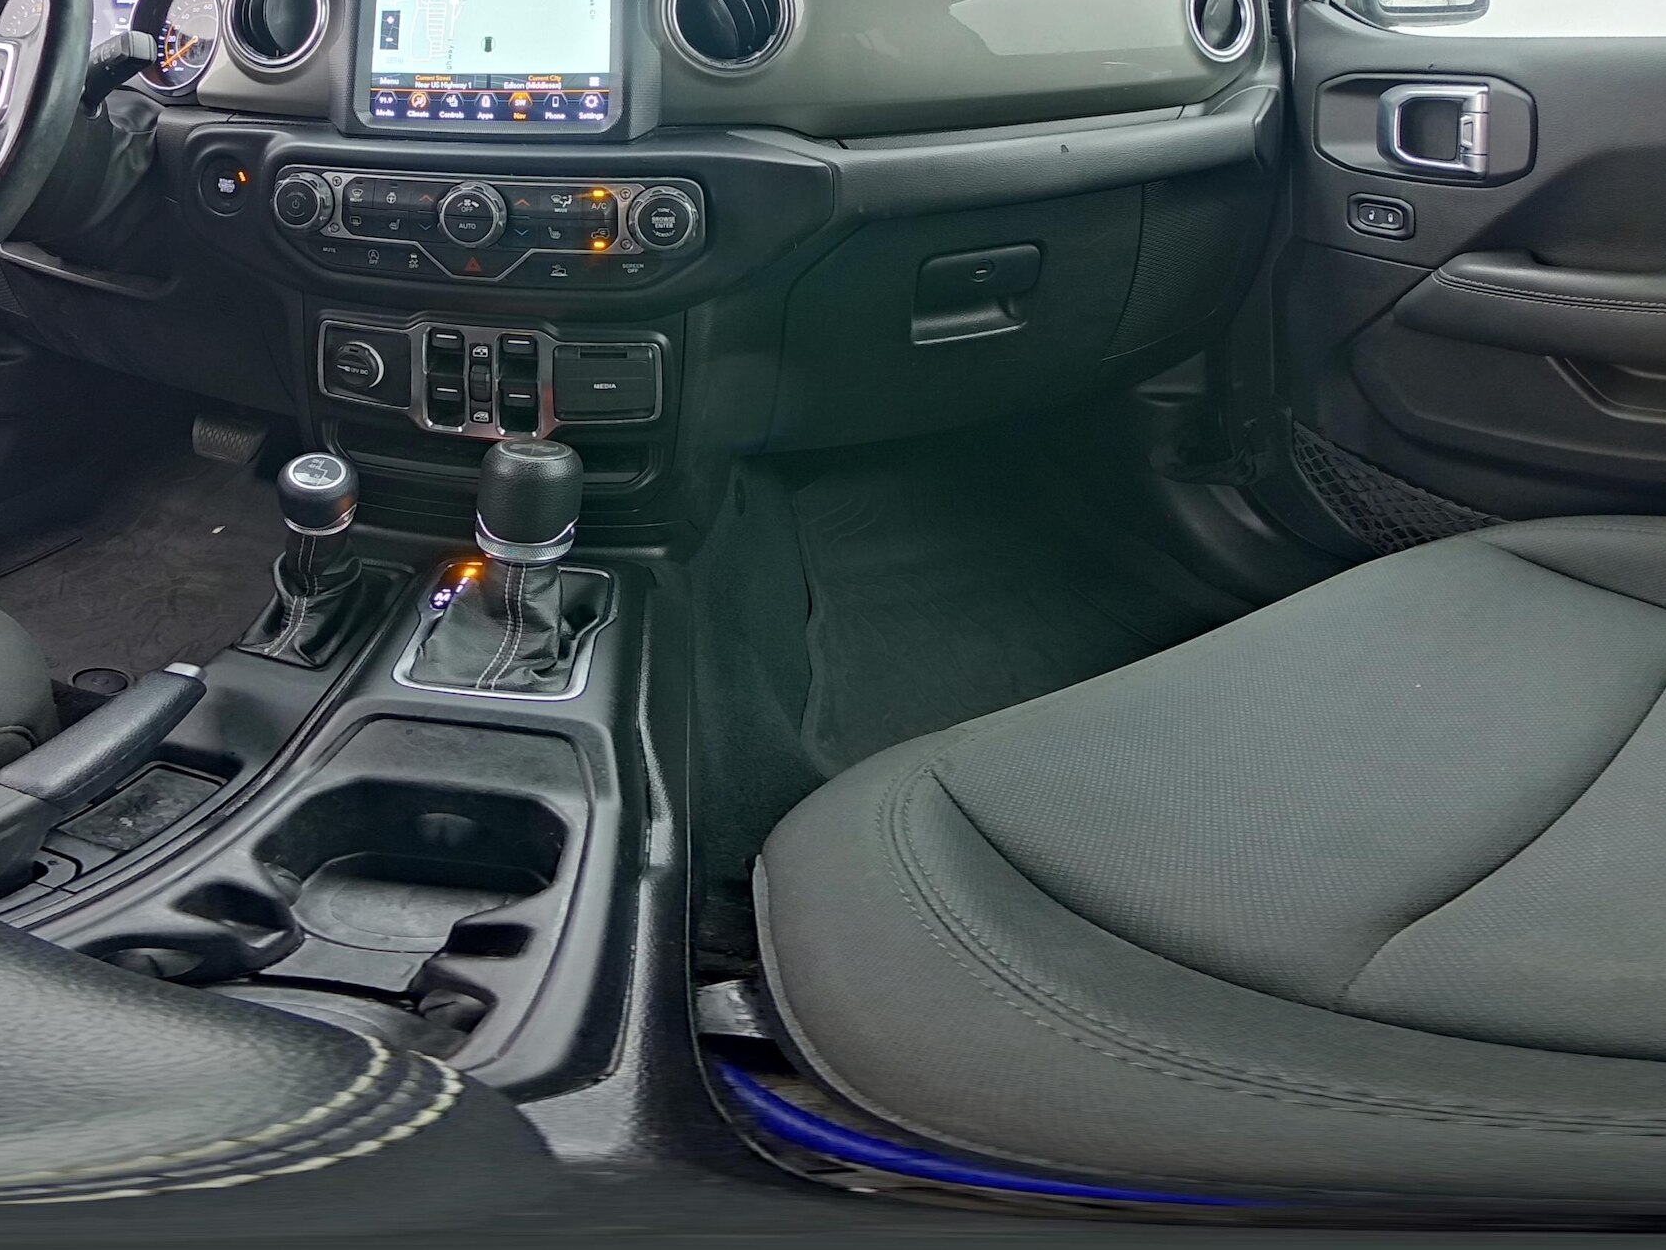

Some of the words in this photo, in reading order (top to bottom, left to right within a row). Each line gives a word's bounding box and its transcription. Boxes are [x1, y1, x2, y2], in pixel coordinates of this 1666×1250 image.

[380, 77, 399, 85] Menu
[440, 82, 467, 90] Highway
[407, 110, 429, 118] Climate
[439, 111, 464, 119] Controls
[477, 112, 494, 120] Apps
[579, 112, 604, 120] Settings
[590, 202, 607, 210] A/C
[434, 592, 451, 601] M
